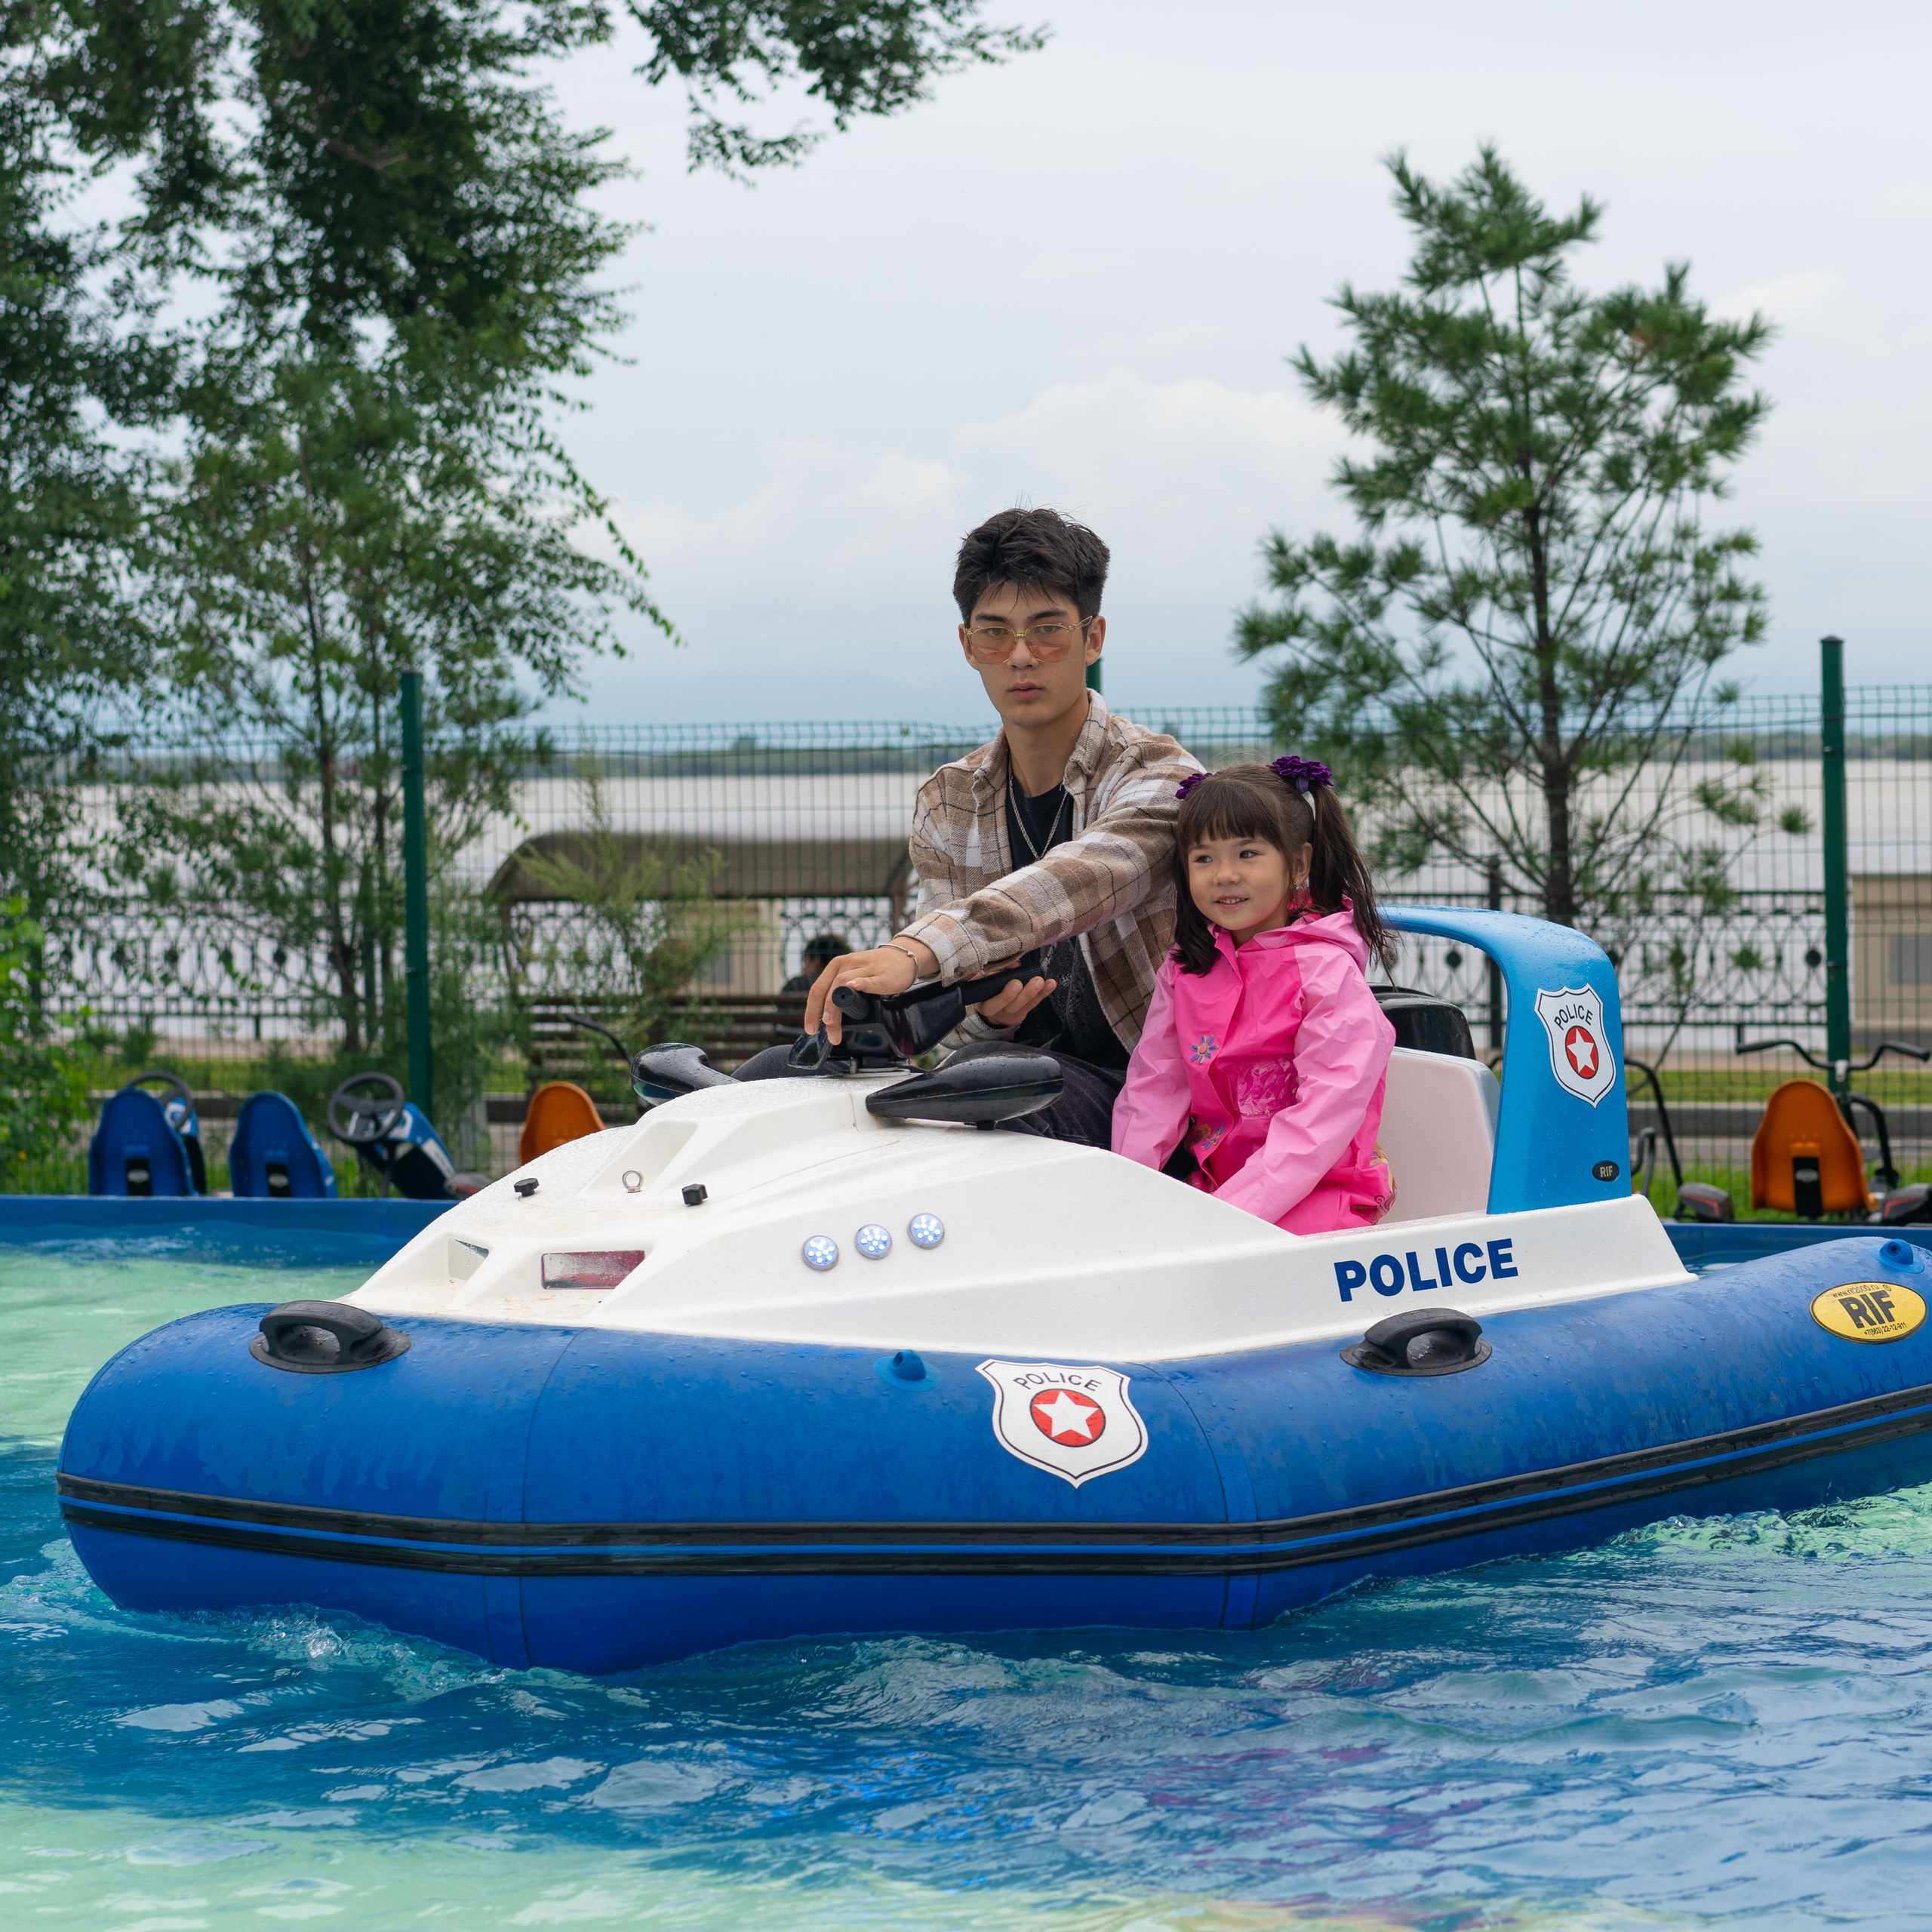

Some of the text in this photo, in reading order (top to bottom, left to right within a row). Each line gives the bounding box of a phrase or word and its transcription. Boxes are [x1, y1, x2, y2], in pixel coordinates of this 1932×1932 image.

[1554, 1004, 1593, 1031] POLICE
[1600, 1165, 1613, 1177] RIF
[1334, 1238, 1518, 1303] POLICE
[1838, 1290, 1896, 1329] RIF
[1013, 1372, 1102, 1392] POLICE
